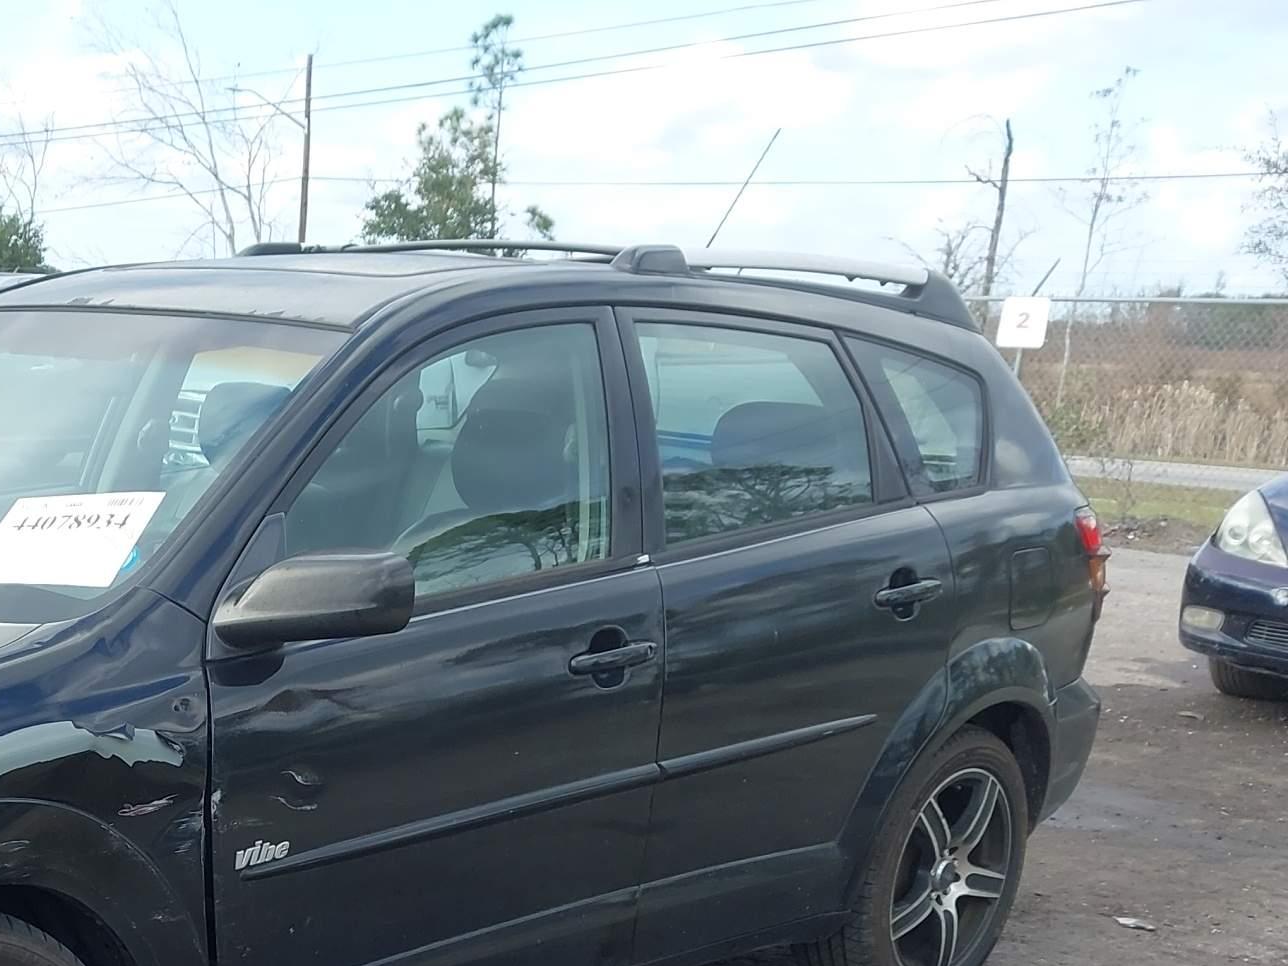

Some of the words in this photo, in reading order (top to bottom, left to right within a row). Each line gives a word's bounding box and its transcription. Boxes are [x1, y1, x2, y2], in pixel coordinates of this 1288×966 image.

[1015, 311, 1031, 329] 2
[12, 513, 131, 531] 44078934
[234, 839, 290, 870] vibe
